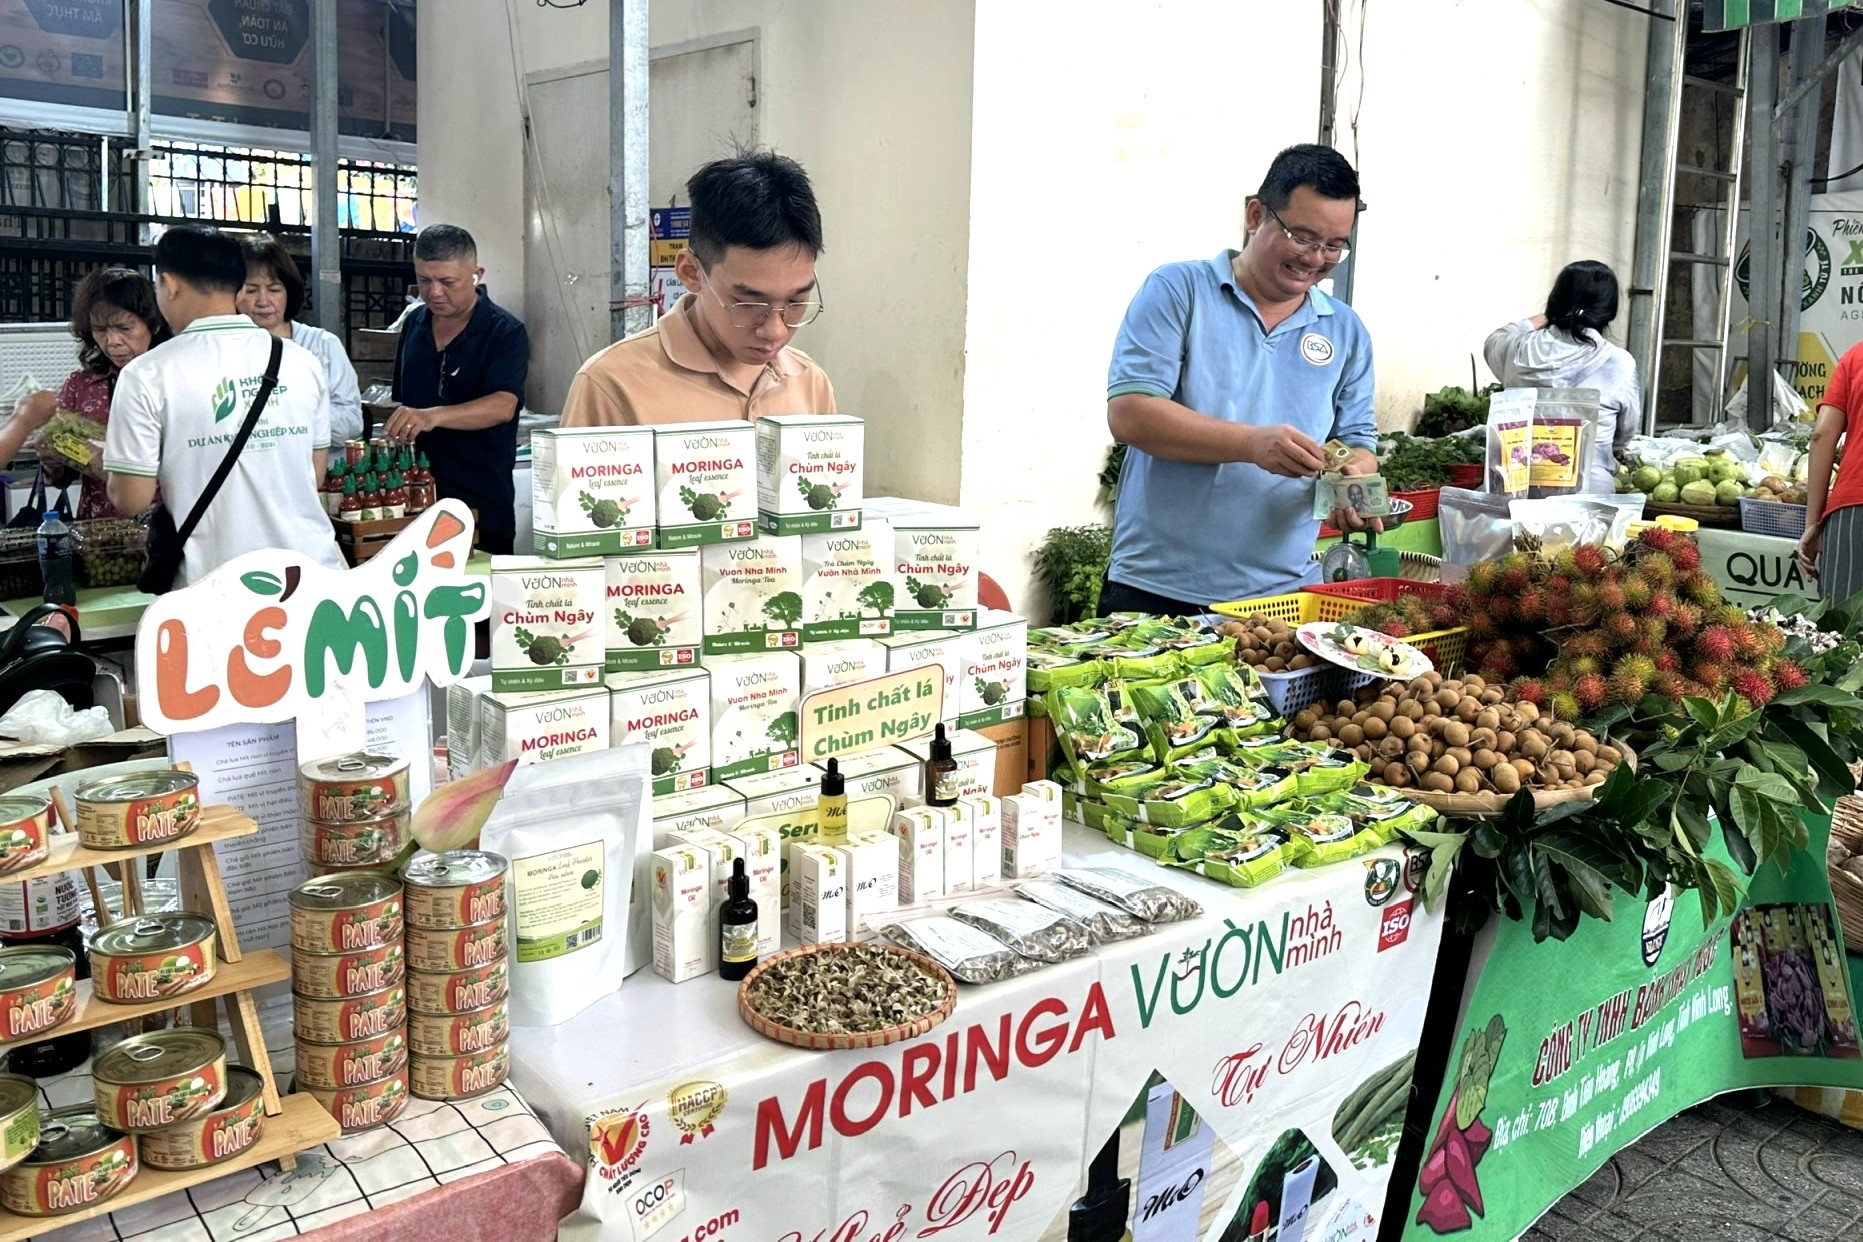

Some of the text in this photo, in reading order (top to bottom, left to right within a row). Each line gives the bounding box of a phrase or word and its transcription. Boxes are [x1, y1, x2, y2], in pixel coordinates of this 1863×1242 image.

[571, 463, 643, 479] MORINGA
[672, 459, 744, 474] MORINGA
[689, 473, 728, 484] Leaf essence
[789, 461, 856, 476] Chùm Ngây
[588, 478, 628, 489] Leaf essence
[720, 568, 743, 576] Vuon
[745, 567, 763, 575] Nha
[898, 563, 969, 576] Chùm Ngây
[607, 583, 684, 597] MORINGA
[624, 597, 668, 607] Leaf essence
[526, 597, 573, 609] Tinh chất lá
[504, 610, 594, 626] Chùm Ngây
[783, 635, 796, 643] ISO
[678, 652, 692, 660] ISO
[968, 658, 1022, 676] Chùm Ngây
[728, 687, 787, 705] Vuon Nha Minh
[814, 698, 860, 725] Tinh
[867, 684, 911, 711] chất
[917, 678, 933, 698] lá
[627, 708, 698, 732] MORINGA
[644, 724, 684, 740] Leaf essence
[521, 727, 597, 751] MORINGA
[814, 712, 932, 757] Chùm Ngây
[539, 745, 582, 761] Leaf essence
[319, 795, 356, 820] PATE
[137, 809, 179, 842] PATE
[321, 838, 358, 862] PATE
[527, 865, 556, 877] MORINGA
[470, 891, 501, 922] PATE
[1289, 900, 1333, 941] nhà
[1382, 913, 1409, 937] ISO
[342, 918, 382, 949] PATE
[464, 936, 496, 966] PATE
[1286, 923, 1342, 970] mình
[116, 971, 160, 999] PATE
[346, 963, 385, 994] PATE
[455, 980, 491, 1010] PATE
[9, 998, 56, 1035] PATE
[350, 1007, 388, 1039] PATE
[459, 1024, 493, 1052] PATE
[1212, 1000, 1387, 1108] Tự Nhiên
[343, 1054, 383, 1085] PATE
[462, 1065, 496, 1093] PATE
[753, 981, 1116, 1171] MORINGA
[127, 1097, 174, 1127] PATE
[678, 1087, 718, 1112] HACCP
[342, 1098, 382, 1128] PATE
[213, 1118, 252, 1158] PATE
[639, 1114, 650, 1138] CAO
[48, 1172, 97, 1209] PATE
[636, 1179, 674, 1215] OCOP
